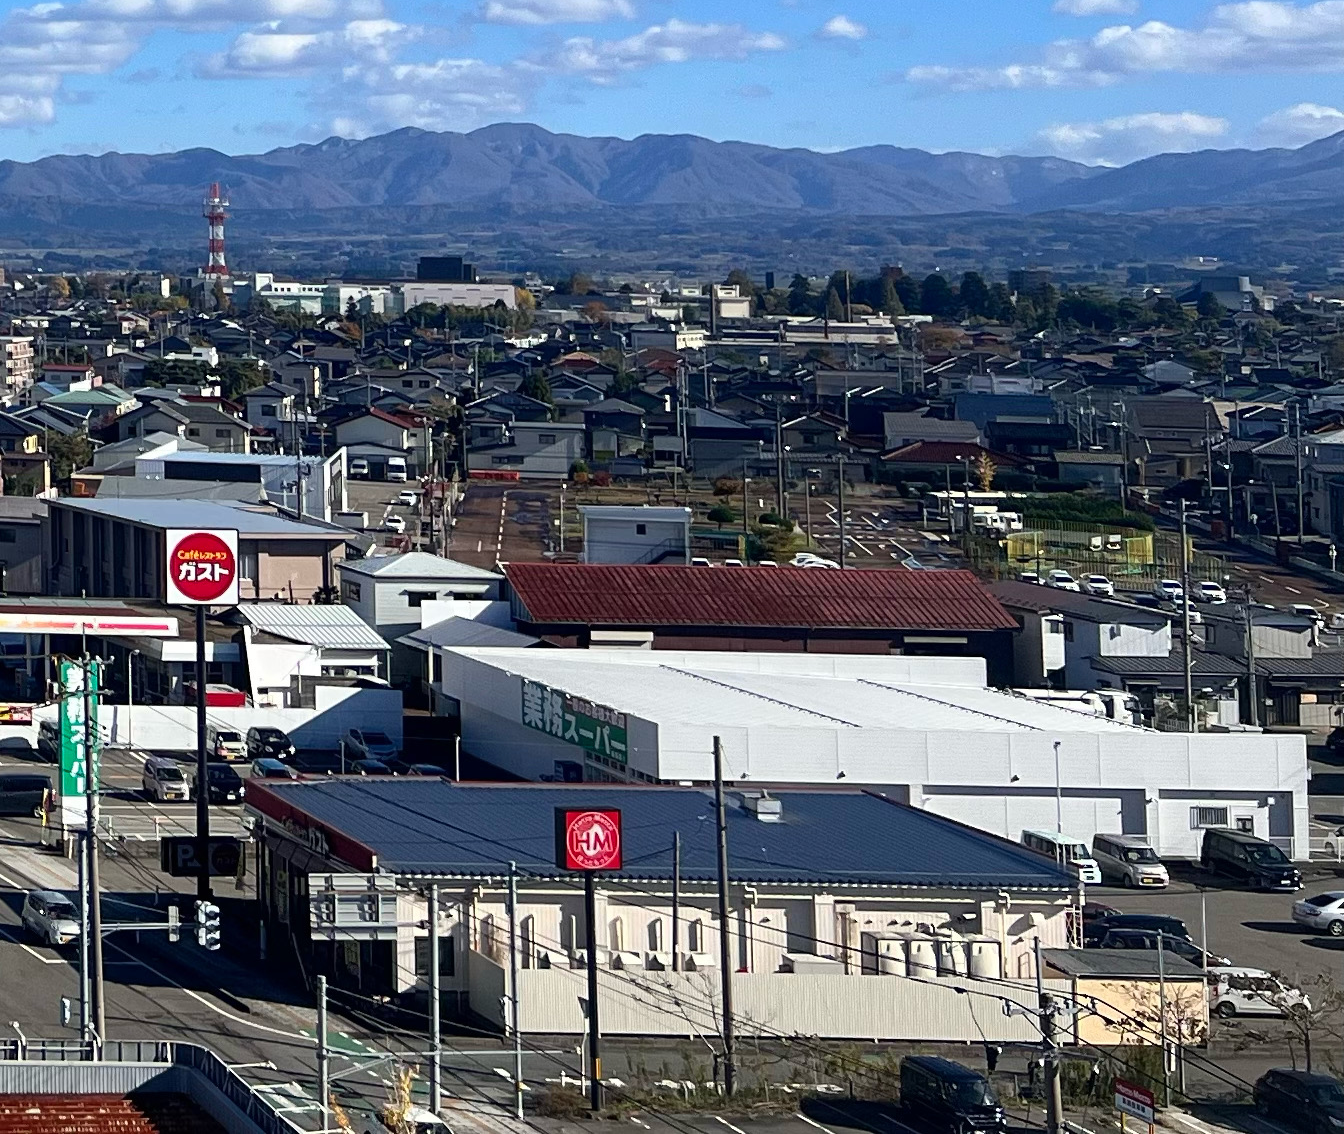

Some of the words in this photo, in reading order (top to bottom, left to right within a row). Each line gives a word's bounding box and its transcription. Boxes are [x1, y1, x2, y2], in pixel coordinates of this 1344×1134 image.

[178, 561, 230, 582] ガスト
[523, 683, 626, 755] 業務スーパー
